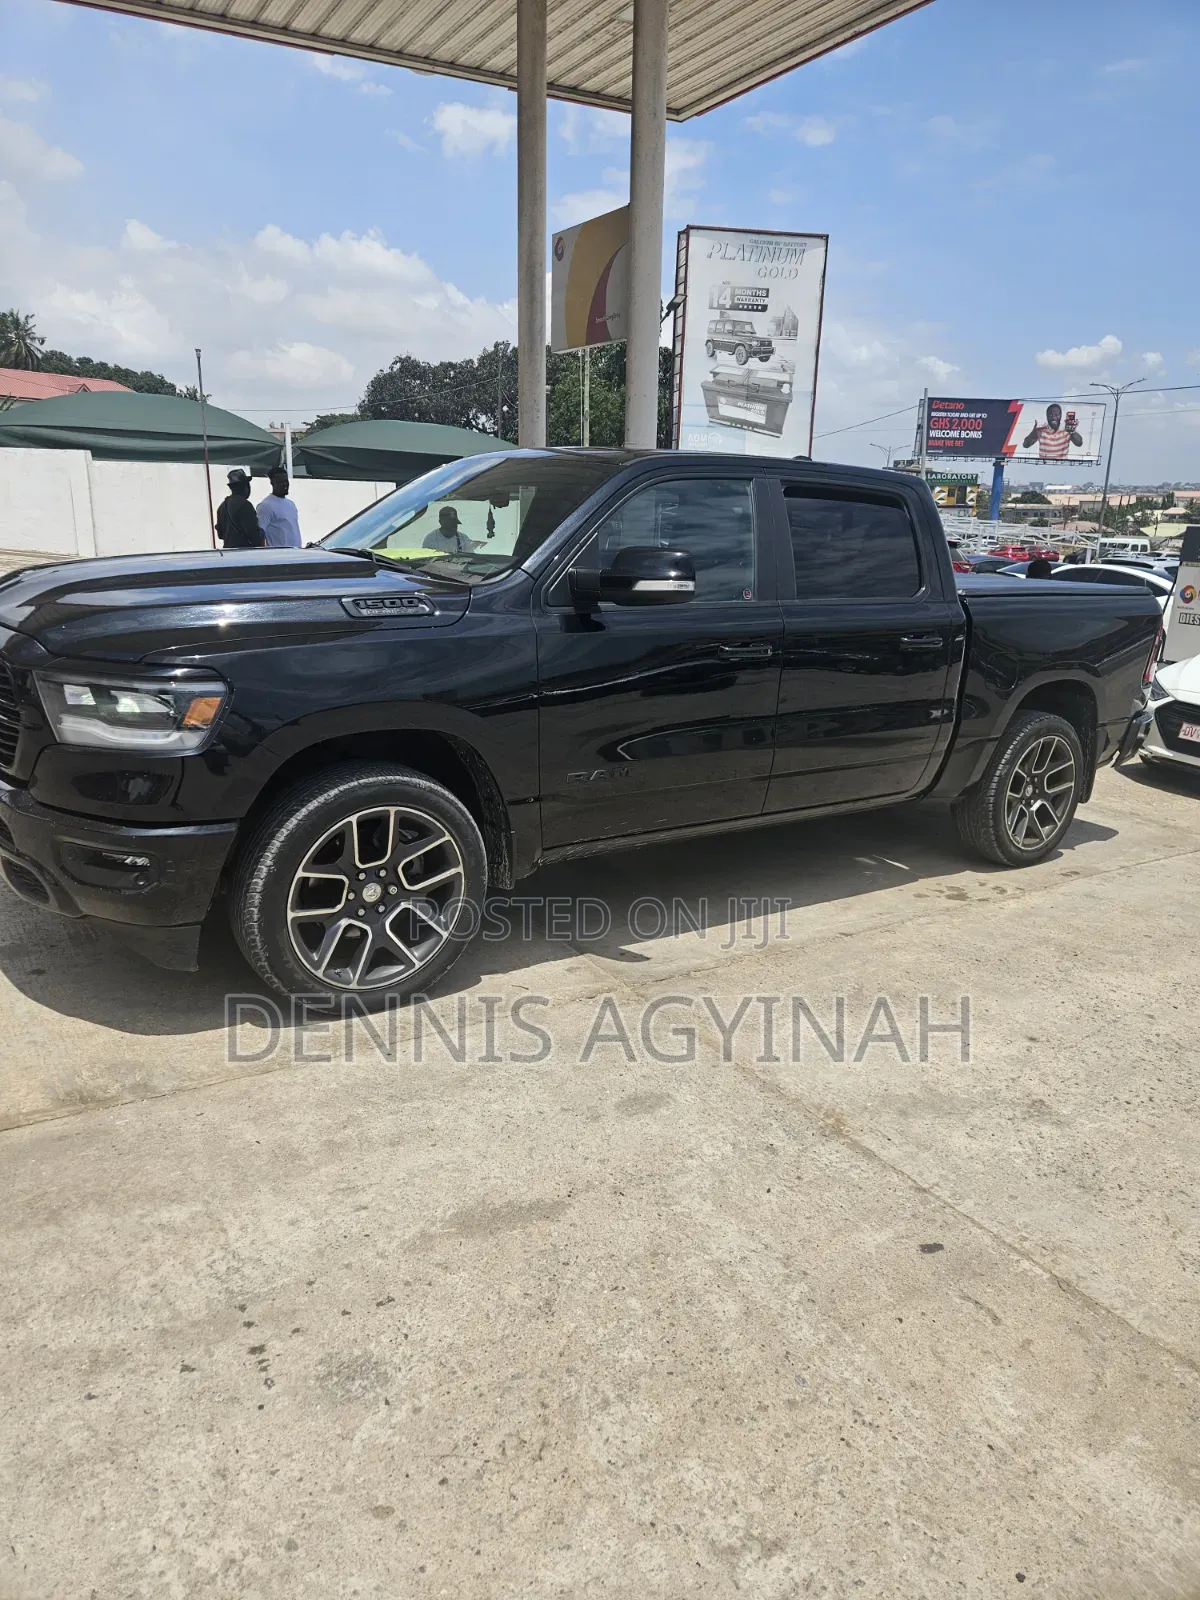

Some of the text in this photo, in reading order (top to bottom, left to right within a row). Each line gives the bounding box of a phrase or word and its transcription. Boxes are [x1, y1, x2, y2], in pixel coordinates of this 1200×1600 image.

[706, 242, 806, 265] PLATINUM
[757, 265, 799, 280] GOLD
[710, 285, 732, 309] 14
[734, 287, 767, 297] MONTHS
[932, 400, 965, 410] Betano
[930, 417, 983, 430] GHS 2,000
[930, 429, 983, 439] WELCOME BONUS
[355, 599, 419, 609] 1500
[566, 767, 633, 783] RAM
